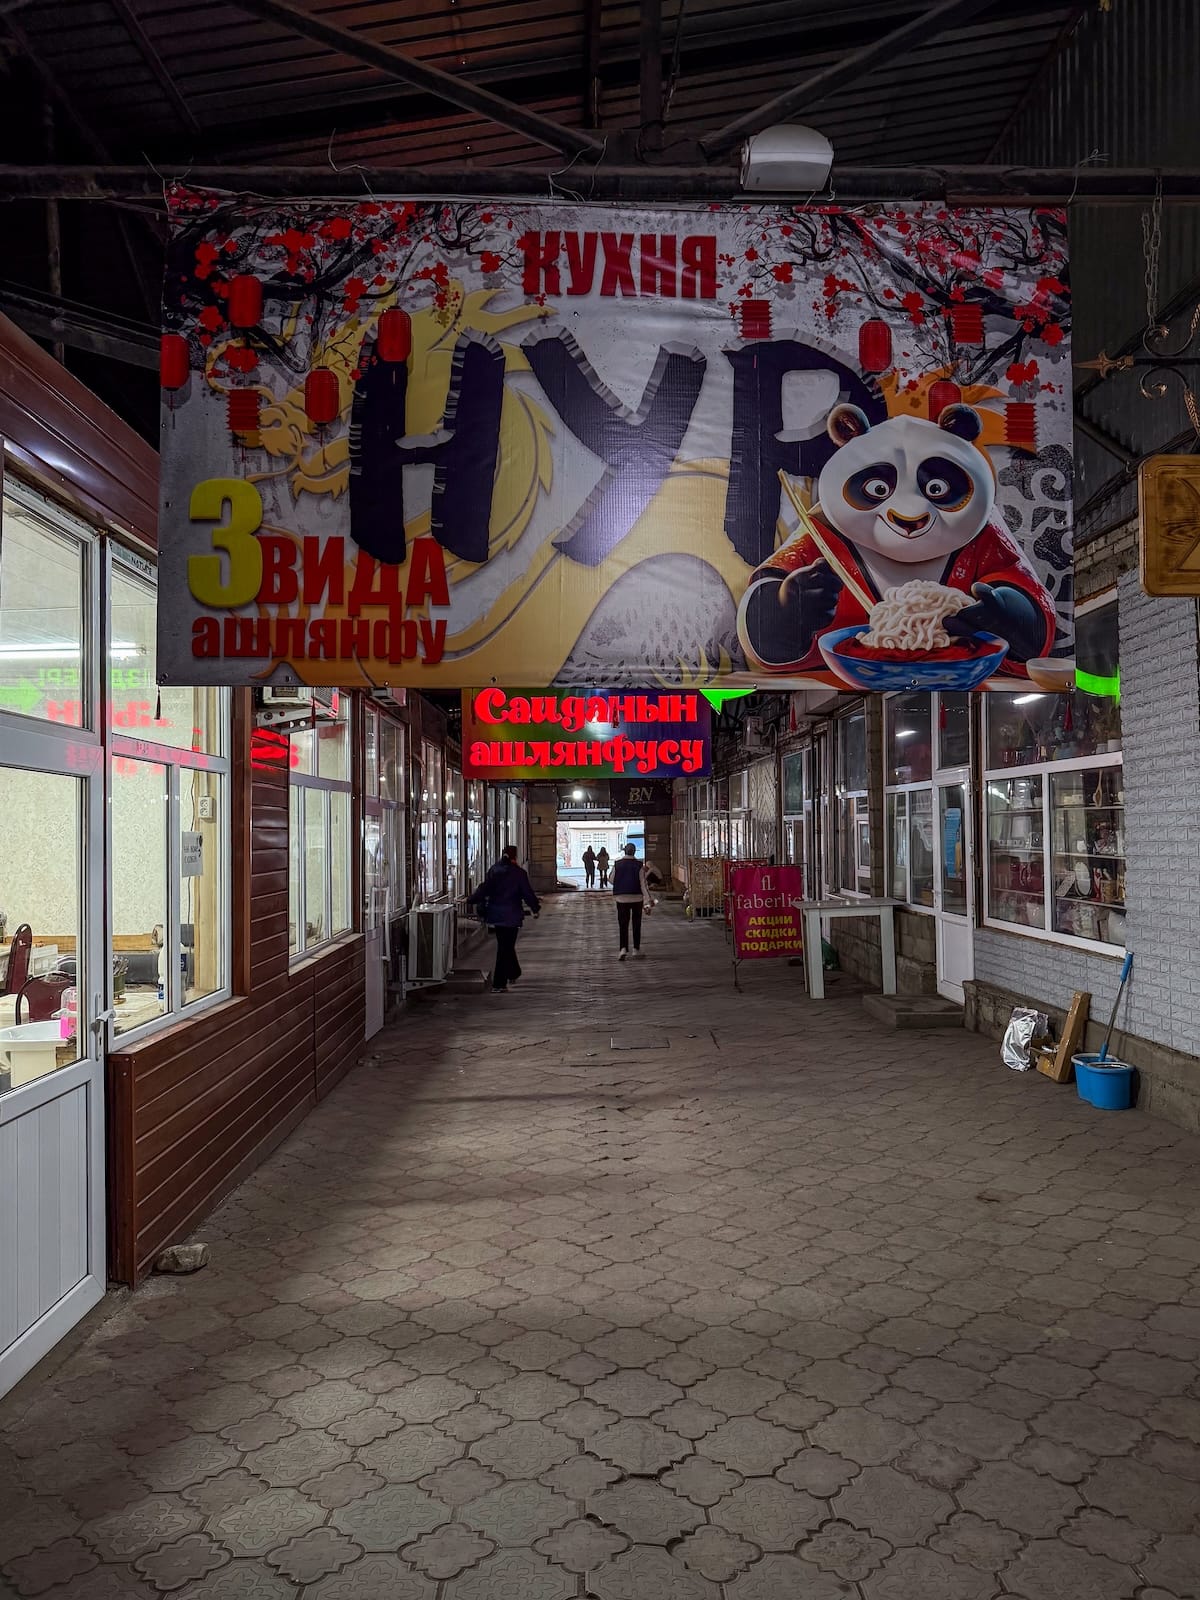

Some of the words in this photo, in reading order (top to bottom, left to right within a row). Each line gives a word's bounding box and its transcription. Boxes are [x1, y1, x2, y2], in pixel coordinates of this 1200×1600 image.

[523, 231, 718, 299] КУХНЯ
[348, 324, 886, 567] НУР
[187, 478, 263, 608] 3
[256, 535, 451, 616] ВИДА
[191, 615, 448, 664] ашлянфу
[469, 733, 704, 773] ашлянфусу
[745, 927, 797, 939] СКИДКИ
[748, 915, 793, 927] АКЦИИ
[740, 940, 803, 952] ПОДАРКИ
